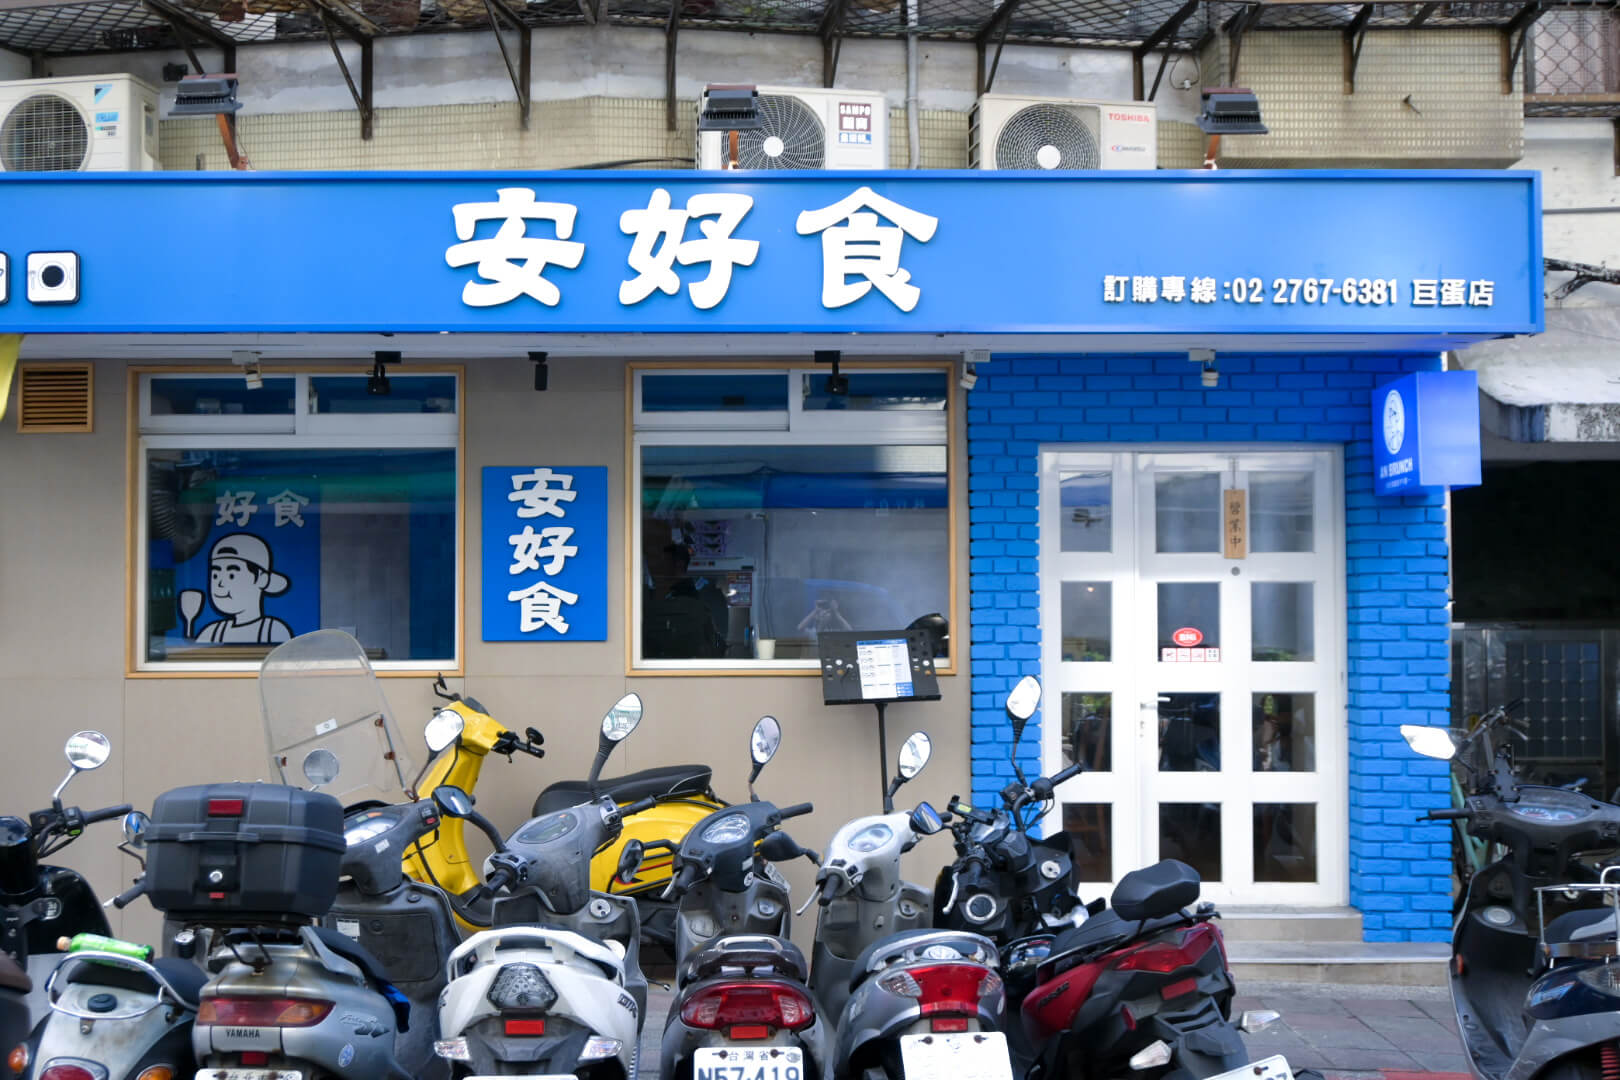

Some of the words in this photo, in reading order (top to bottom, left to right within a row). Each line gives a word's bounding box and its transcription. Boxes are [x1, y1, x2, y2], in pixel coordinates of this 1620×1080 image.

[840, 104, 871, 116] SAMPO
[1108, 112, 1150, 122] TOSHIBA
[445, 187, 938, 312] 安好食
[1272, 277, 1398, 306] 2767-6381
[1412, 278, 1495, 307] 巨蛋店
[215, 489, 309, 527] 好食
[508, 468, 579, 634] 安好食
[225, 1028, 261, 1039] YAMAHA
[729, 1050, 769, 1061] 台灣省
